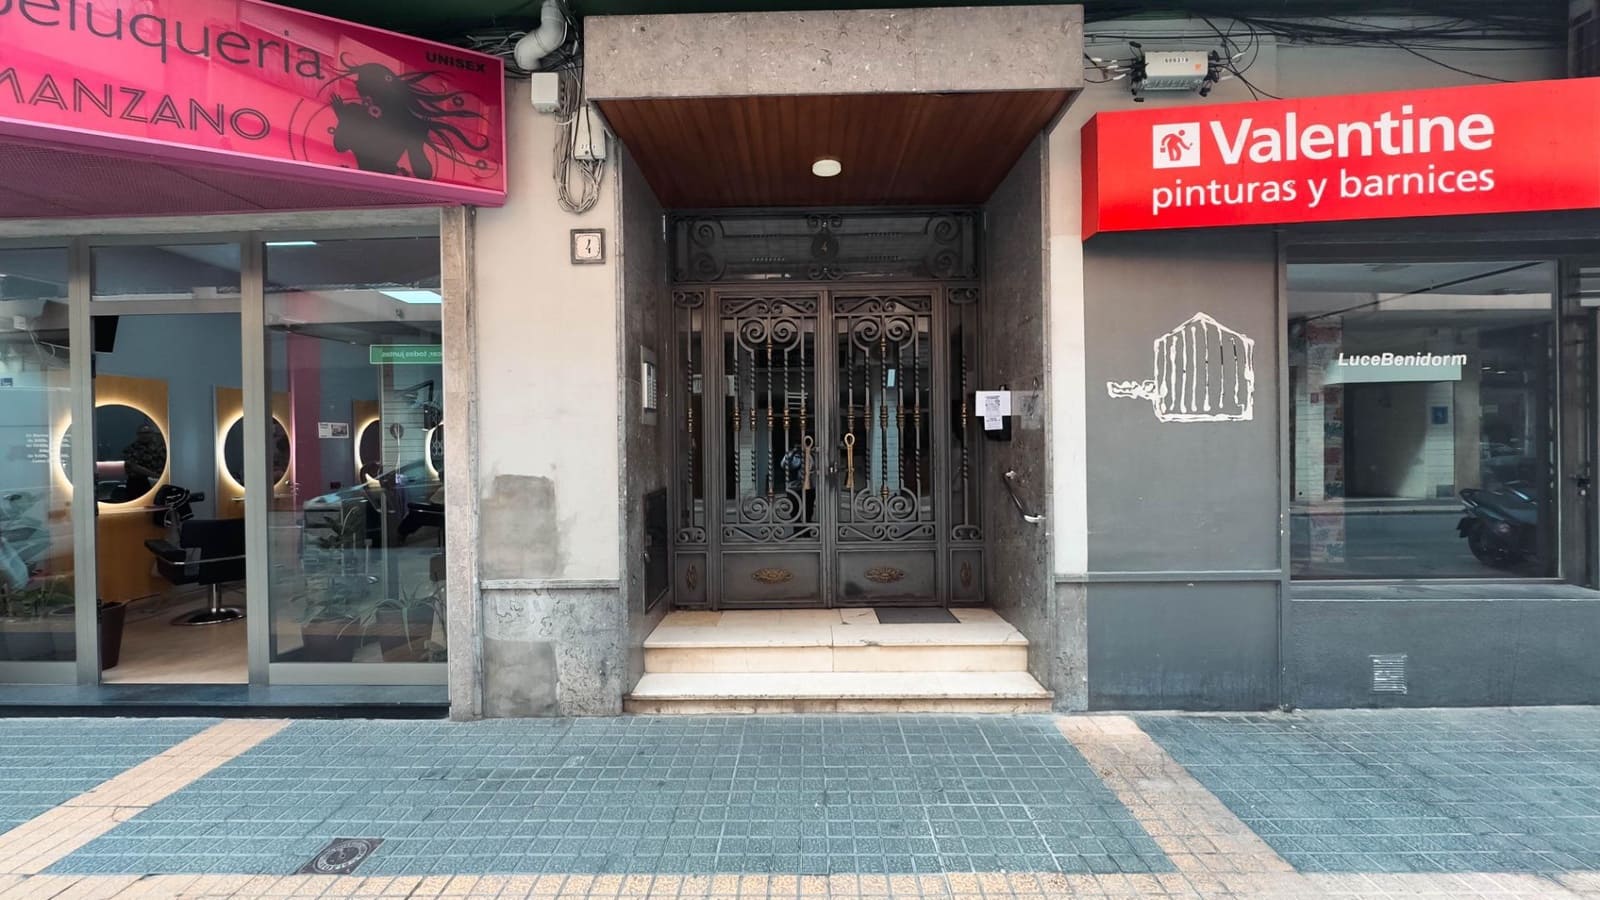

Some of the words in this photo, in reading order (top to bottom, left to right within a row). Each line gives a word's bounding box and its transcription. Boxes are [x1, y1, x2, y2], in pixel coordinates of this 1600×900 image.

[0, 0, 325, 80] eluqueria
[425, 51, 486, 72] UNISEX
[1209, 104, 1495, 165] Valentine
[1152, 178, 1297, 216] pinturas
[1308, 177, 1328, 208] y
[1340, 164, 1495, 198] barnices
[585, 239, 591, 254] 4
[1337, 352, 1467, 367] LuceBenidorm
